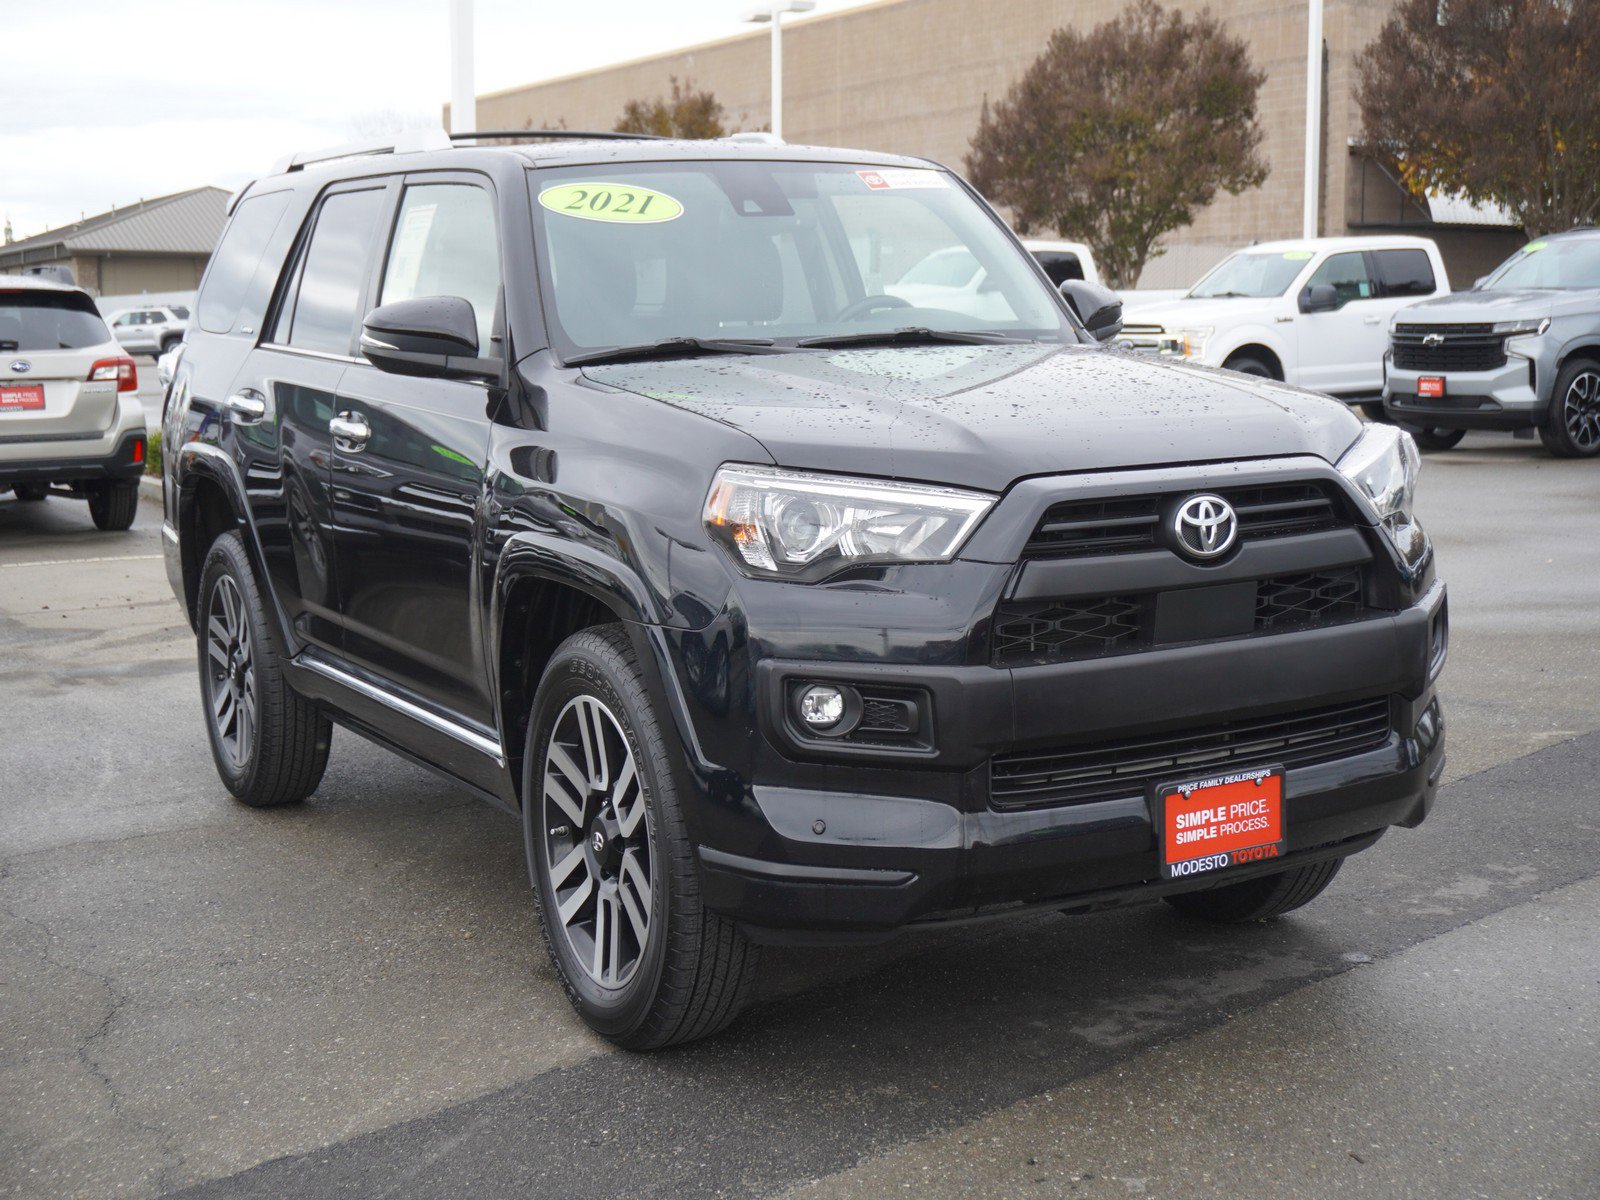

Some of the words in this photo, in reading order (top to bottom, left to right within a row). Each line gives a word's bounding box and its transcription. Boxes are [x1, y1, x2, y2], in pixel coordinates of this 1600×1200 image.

[564, 190, 655, 215] 2021
[1177, 784, 1199, 793] PRICE
[1199, 778, 1223, 789] FAMILY
[1224, 770, 1270, 783] DEALERSHIPS
[1176, 806, 1227, 829] SIMPLE
[1230, 798, 1270, 819] PRICE.
[1176, 826, 1217, 845] SIMPLE
[1220, 816, 1270, 836] PROCESS.
[1171, 853, 1228, 878] MODESTO
[1231, 843, 1278, 864] TOYOTA
